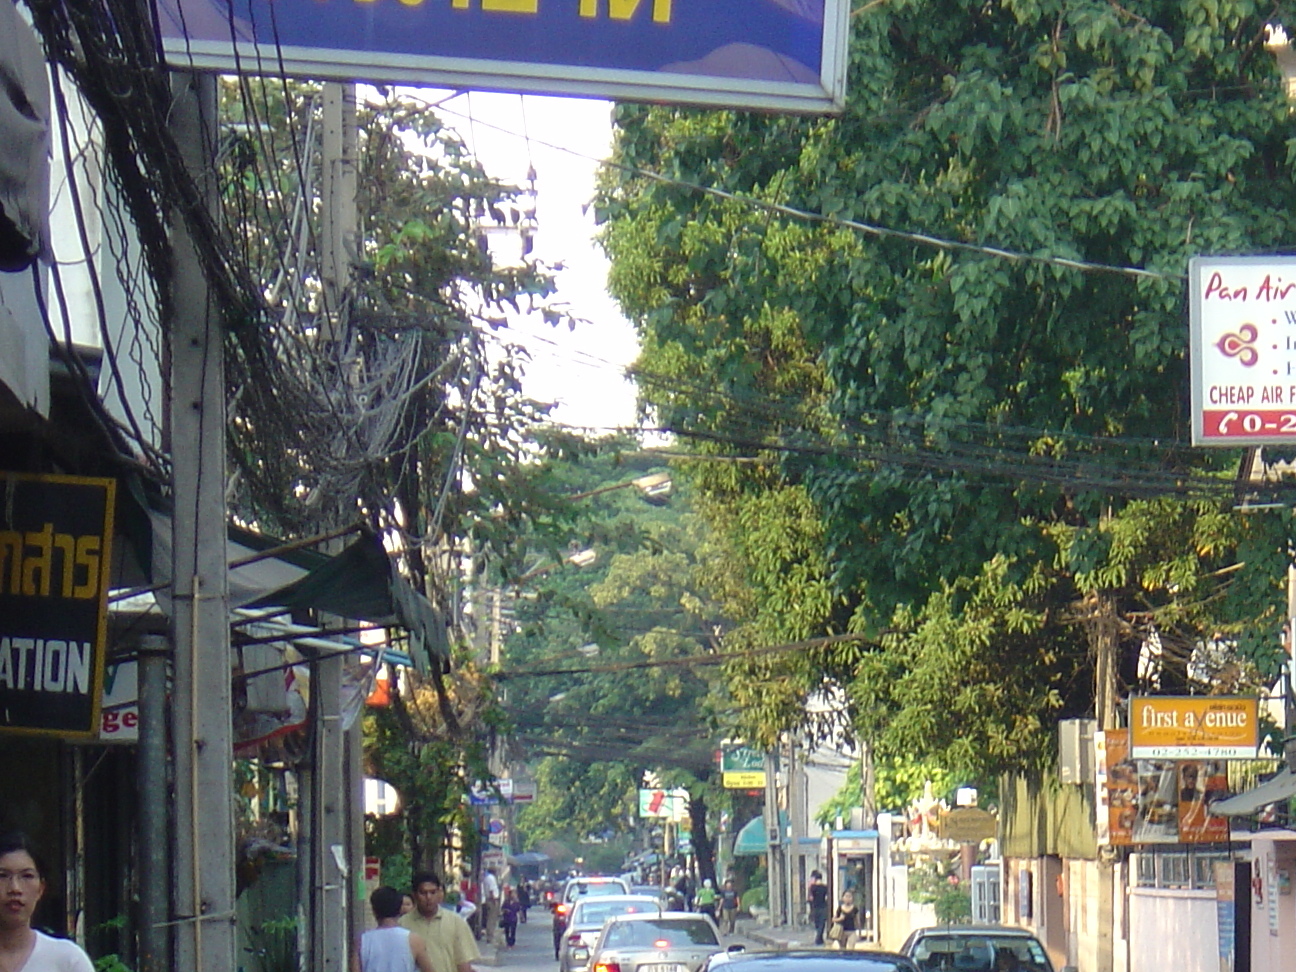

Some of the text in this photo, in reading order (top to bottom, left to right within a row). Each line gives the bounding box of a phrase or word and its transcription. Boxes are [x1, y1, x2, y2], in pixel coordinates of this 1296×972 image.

[1205, 271, 1248, 302] Pan
[1256, 274, 1296, 302] Air
[1209, 385, 1254, 404] CHEAP
[1261, 385, 1283, 404] AIR
[0, 637, 91, 695] ATION
[1142, 705, 1178, 727] first
